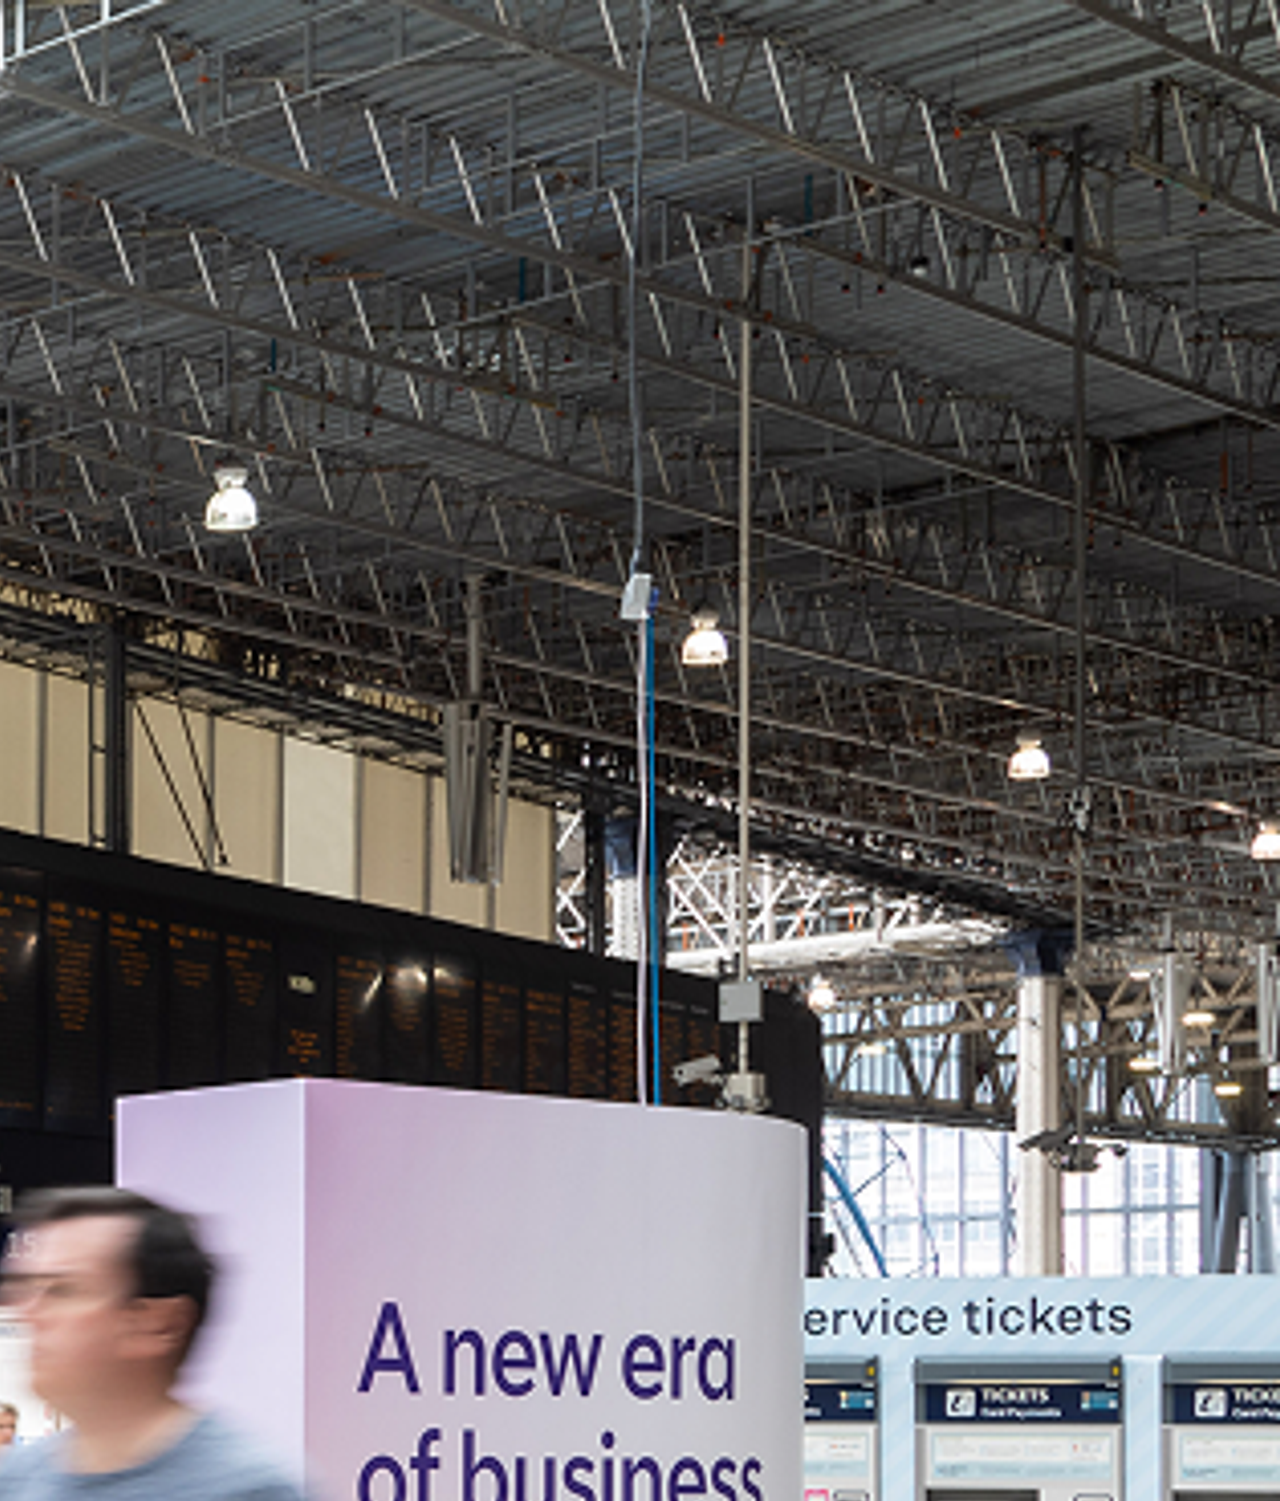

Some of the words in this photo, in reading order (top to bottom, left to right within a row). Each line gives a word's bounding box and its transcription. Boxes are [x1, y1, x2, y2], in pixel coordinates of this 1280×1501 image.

[804, 1297, 948, 1335] ervice
[962, 1295, 1132, 1335] tickets
[357, 1301, 420, 1393] A
[443, 1329, 603, 1396] new
[622, 1334, 736, 1401] era
[980, 1387, 1050, 1405] TICKETS
